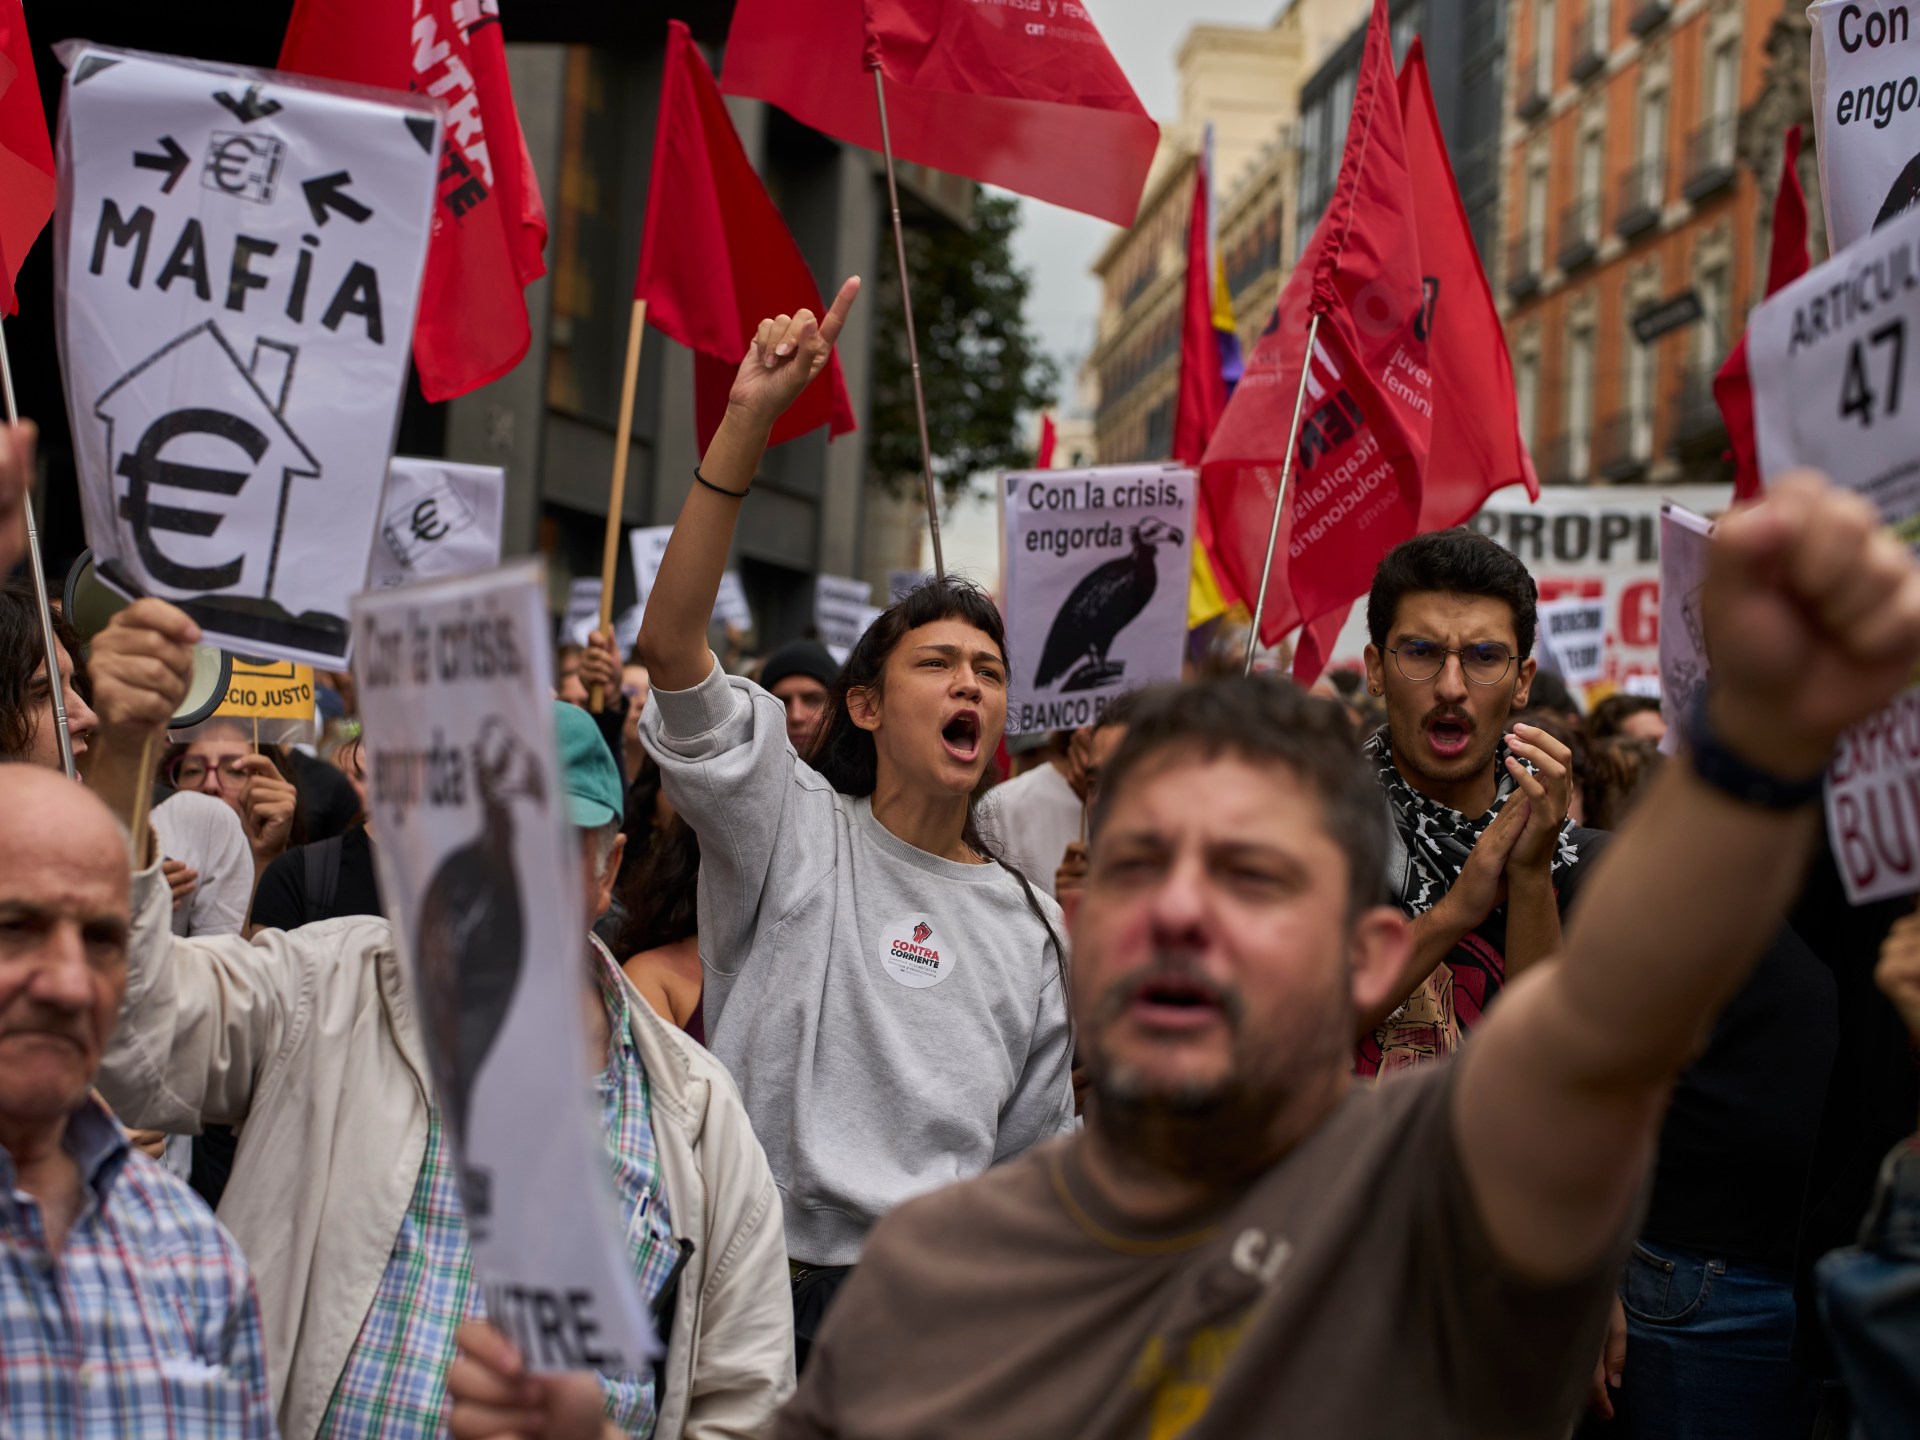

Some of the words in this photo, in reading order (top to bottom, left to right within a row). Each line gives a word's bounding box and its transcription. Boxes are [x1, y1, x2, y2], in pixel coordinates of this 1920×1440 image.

[1838, 4, 1909, 54] Con
[1836, 75, 1920, 129] engo
[1788, 244, 1920, 357] ARTICUL
[1838, 314, 1907, 428] 47
[1027, 482, 1077, 511] Con
[1084, 480, 1107, 510] la
[1112, 478, 1184, 510] crisis,
[1025, 520, 1124, 557] engorda
[261, 683, 311, 707] JUSTO
[1020, 698, 1090, 731] BANCO
[890, 948, 940, 969] CORRIENTE
[892, 939, 940, 961] CONTRA
